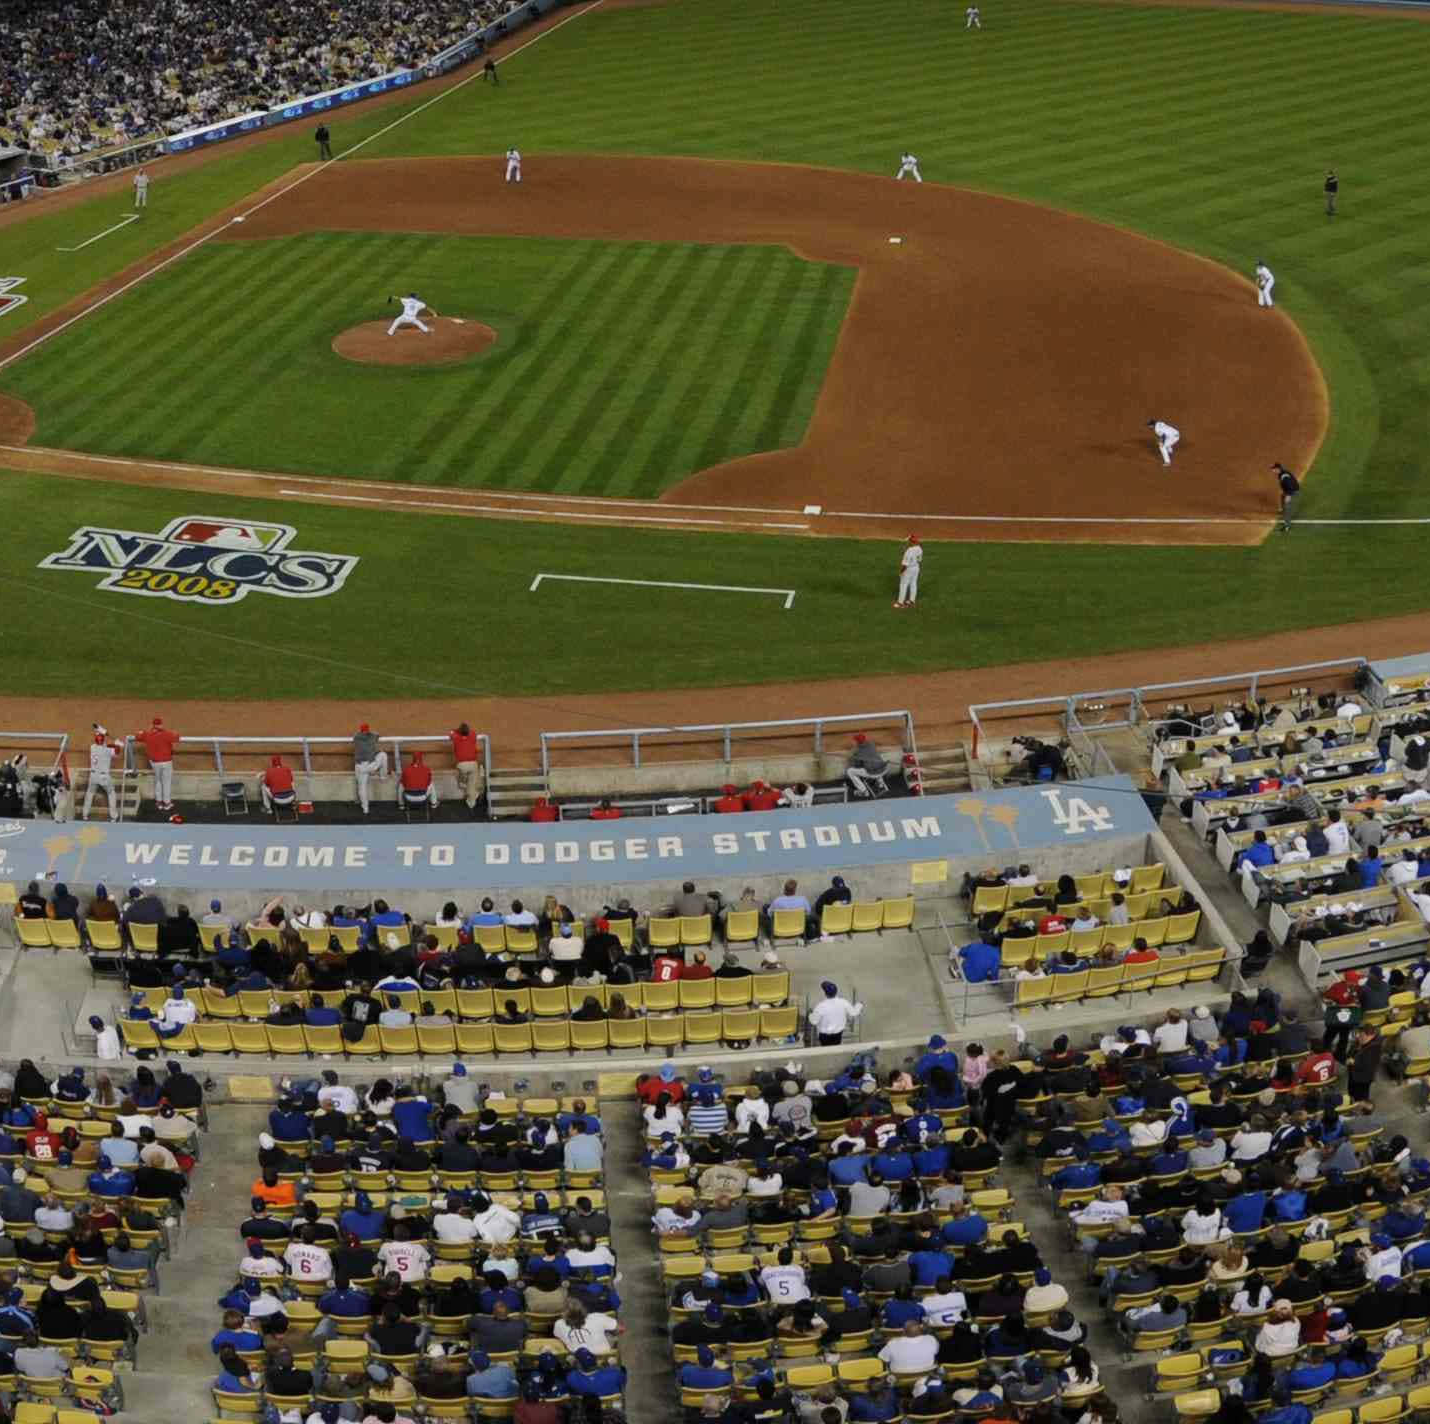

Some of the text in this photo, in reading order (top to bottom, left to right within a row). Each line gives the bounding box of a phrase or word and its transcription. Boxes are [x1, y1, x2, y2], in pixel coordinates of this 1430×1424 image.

[50, 530, 345, 592] NLCS
[116, 569, 237, 599] 2008
[1041, 788, 1117, 834] LA
[124, 816, 942, 868] WELCOME TO DODGER STADIUM
[300, 1259, 312, 1275] 6
[397, 1257, 409, 1271] 5
[778, 1280, 789, 1296] 5
